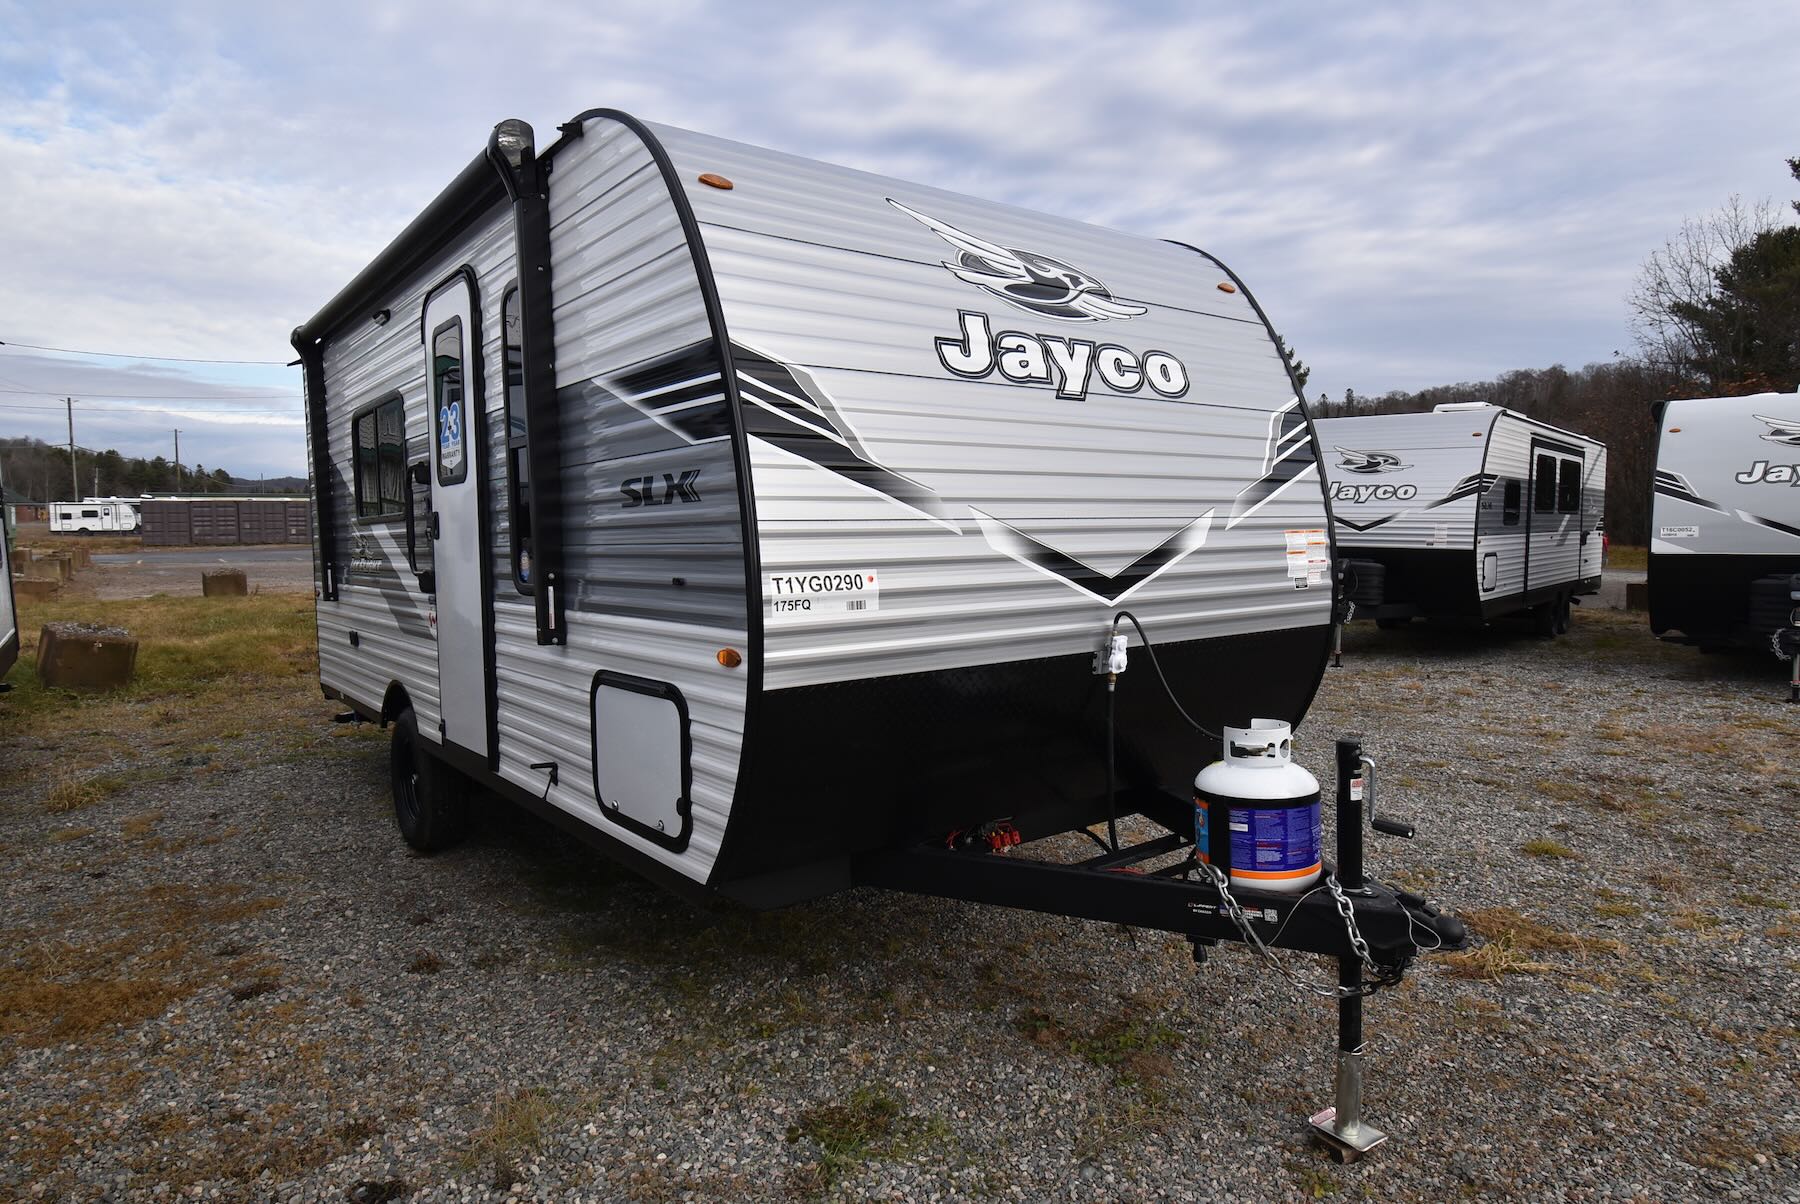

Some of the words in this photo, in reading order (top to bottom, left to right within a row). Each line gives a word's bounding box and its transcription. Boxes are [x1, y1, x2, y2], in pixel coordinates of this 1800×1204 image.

[934, 309, 1190, 401] Jayco
[620, 469, 700, 508] SLX
[1329, 481, 1417, 504] Jayco
[772, 574, 863, 594] T1YG0290
[773, 599, 811, 612] 175FQ
